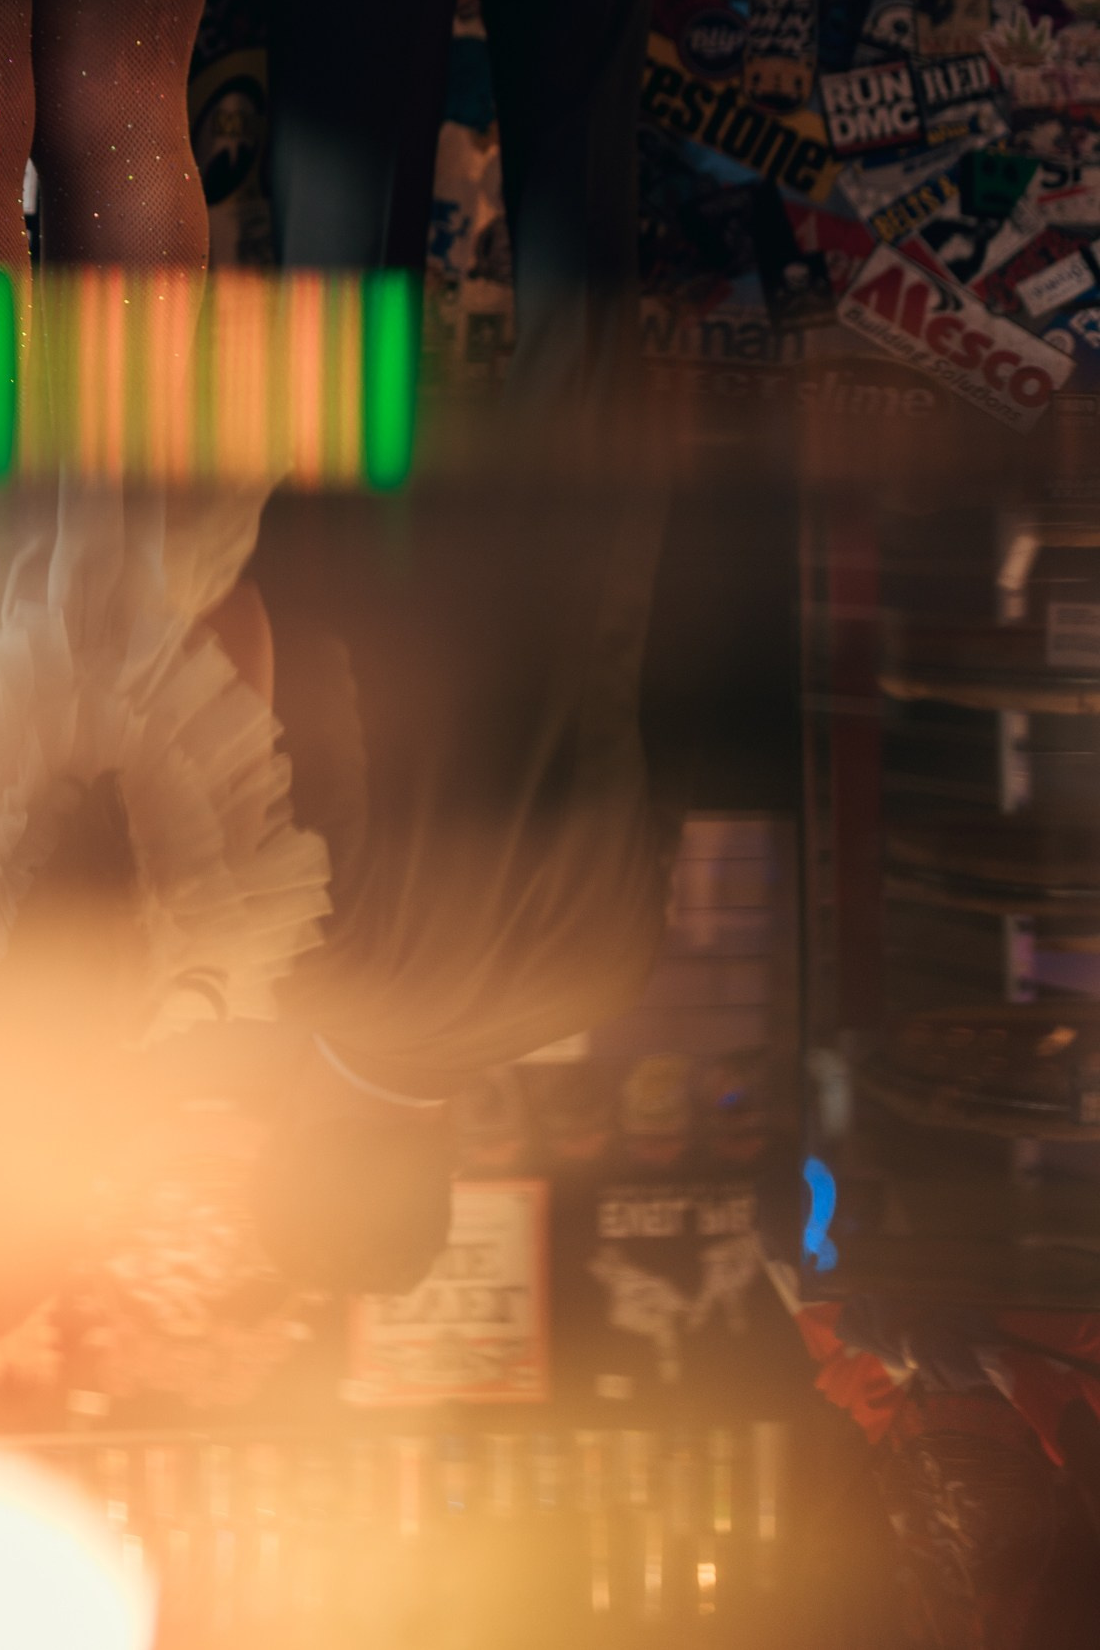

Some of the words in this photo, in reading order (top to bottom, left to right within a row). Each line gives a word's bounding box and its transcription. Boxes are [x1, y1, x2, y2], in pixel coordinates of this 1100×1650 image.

[640, 62, 828, 193] estone
[822, 70, 914, 112] RUN
[829, 99, 920, 146] DMC
[845, 305, 928, 364] Building
[932, 357, 1022, 422] Solutions
